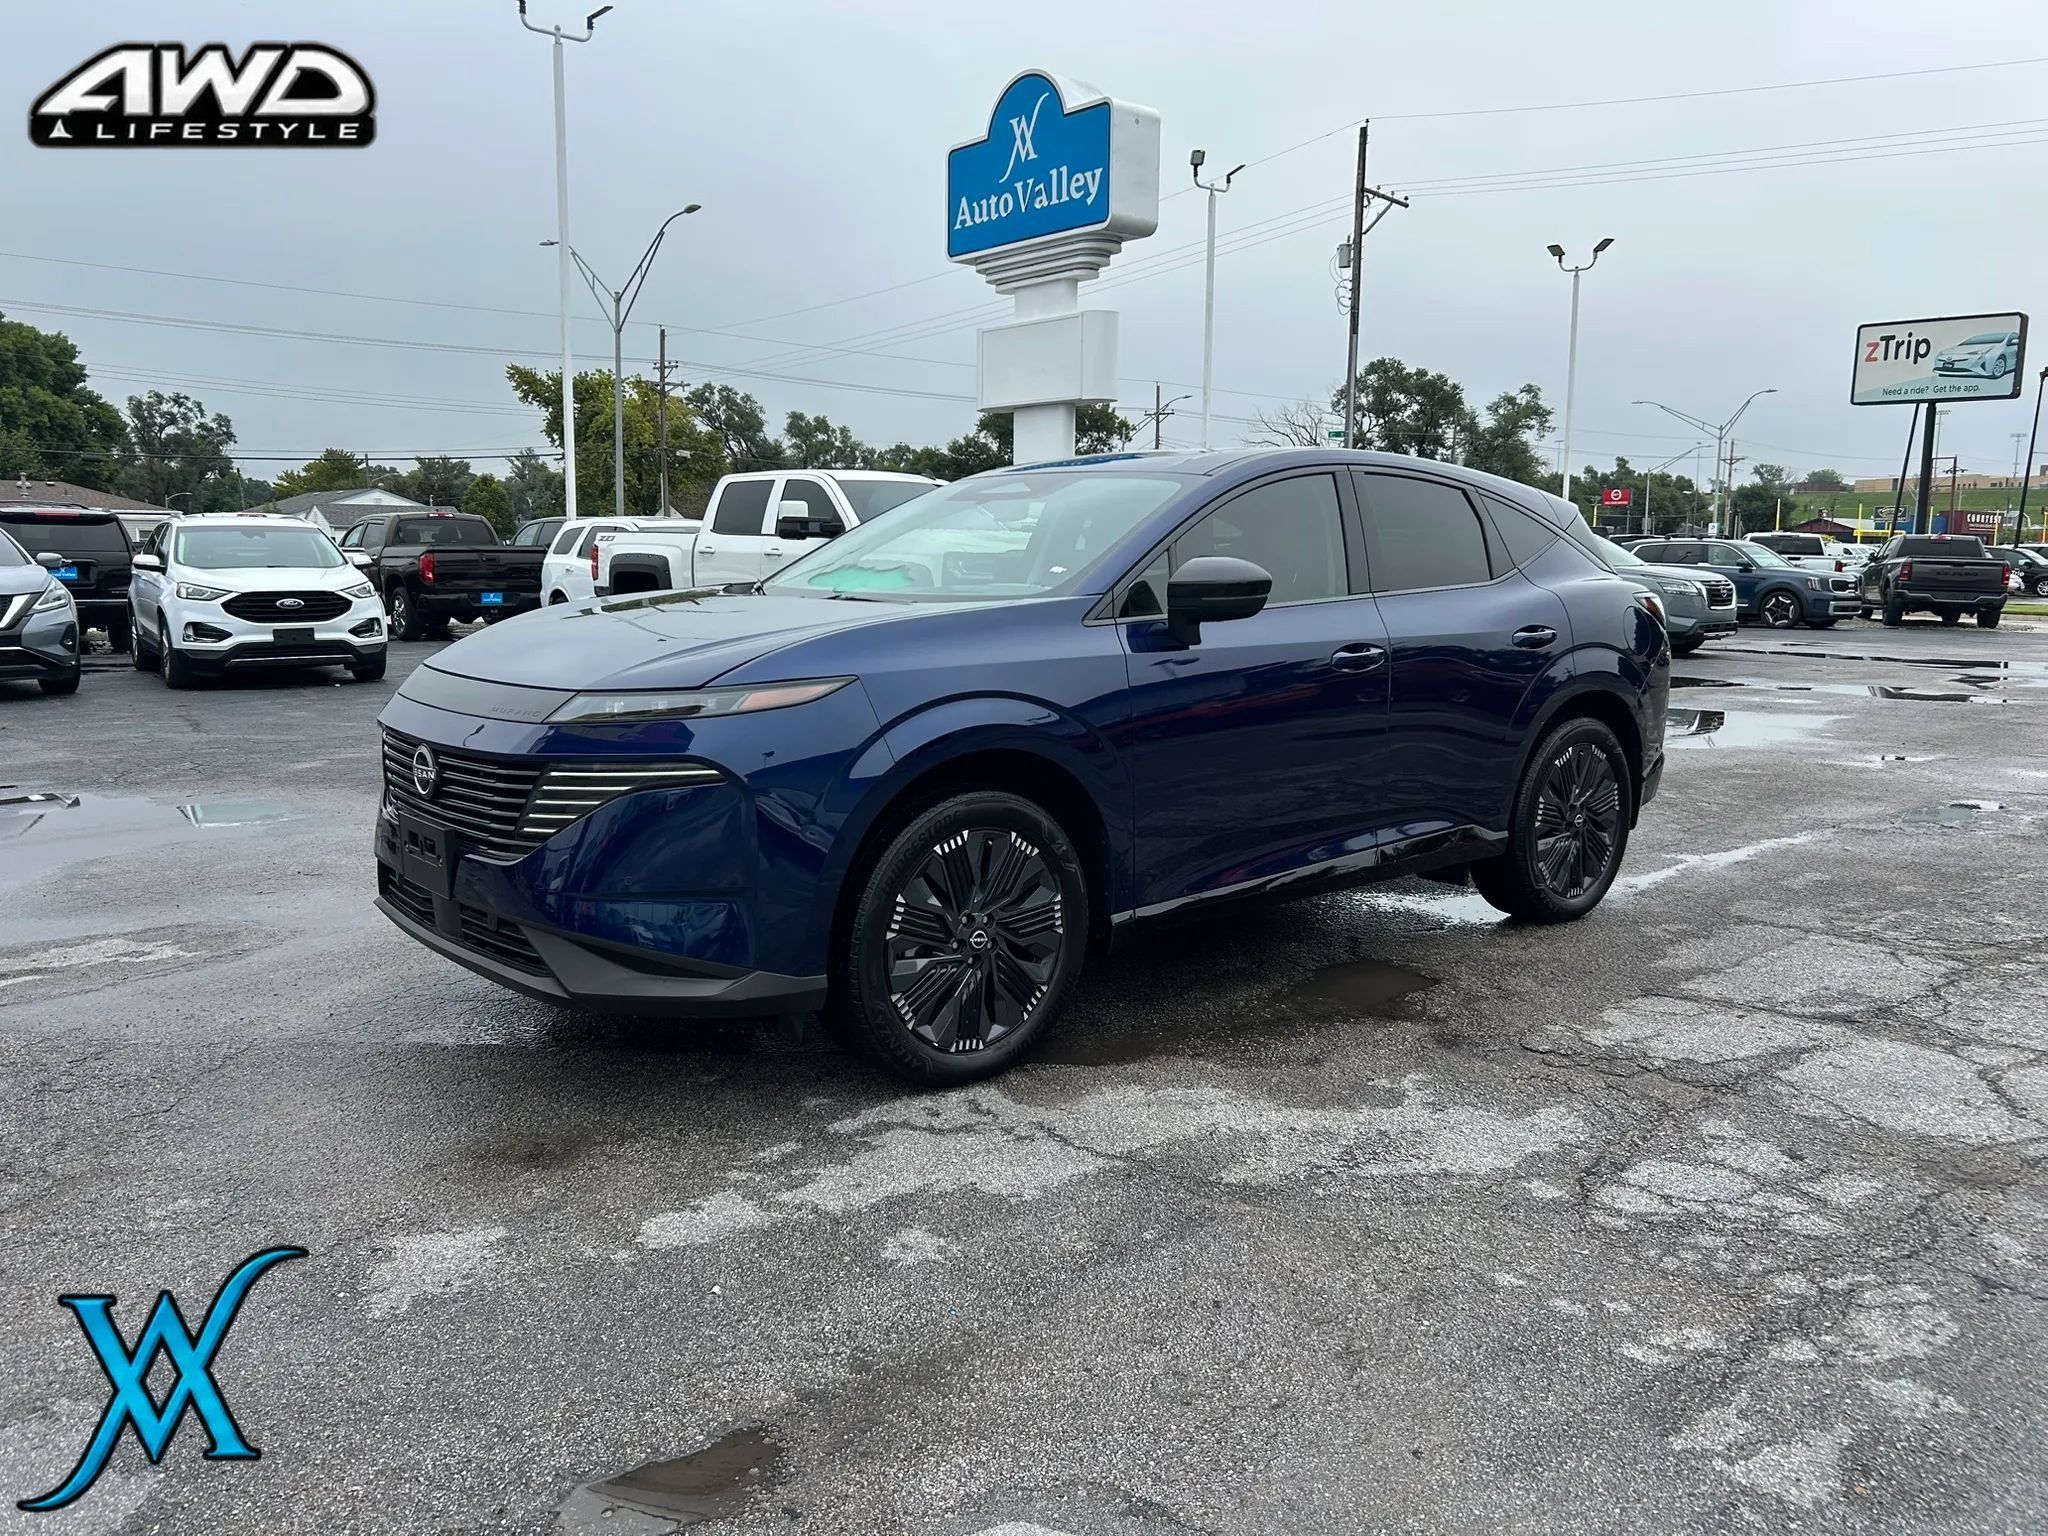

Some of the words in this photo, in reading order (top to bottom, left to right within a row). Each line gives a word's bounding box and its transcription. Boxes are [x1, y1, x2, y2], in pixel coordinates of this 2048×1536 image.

[1864, 331, 1931, 365] zTrip
[1882, 386, 1902, 396] Need
[1909, 385, 1930, 395] ride?
[1933, 384, 1947, 394] Get
[1948, 384, 1962, 394] the
[1963, 384, 1981, 394] app.
